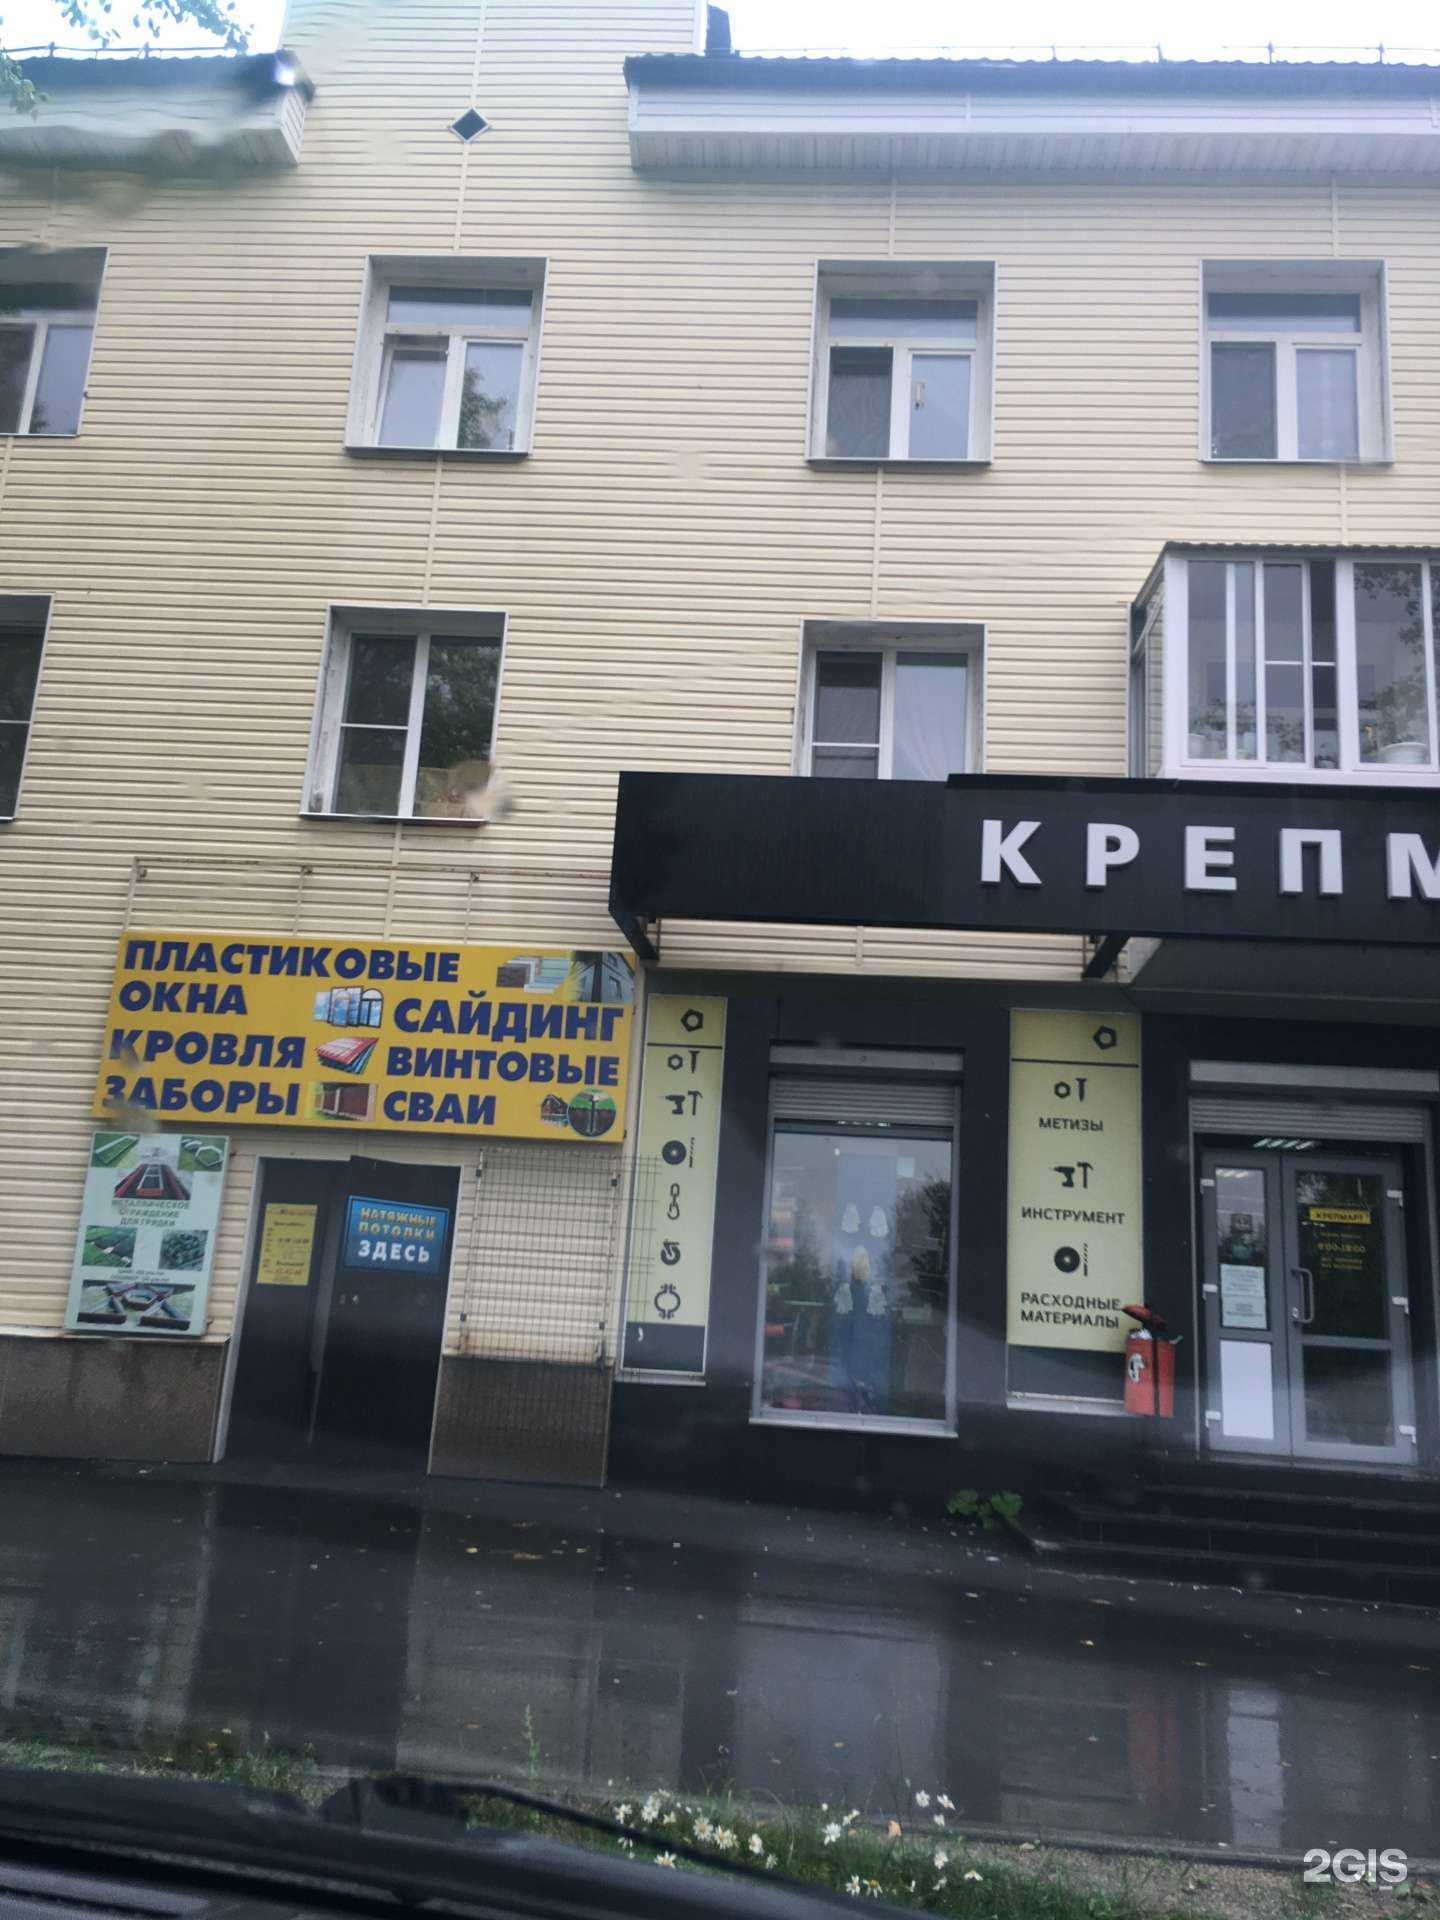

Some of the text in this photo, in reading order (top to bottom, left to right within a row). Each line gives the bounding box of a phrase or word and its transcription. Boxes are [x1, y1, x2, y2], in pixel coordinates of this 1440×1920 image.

[123, 939, 460, 983] ПЛАСТИКОВЫЕ
[118, 979, 248, 1016] ОКНА
[393, 989, 625, 1044] САЙДИНГ
[108, 1028, 307, 1069] КРОВЛЯ
[386, 1046, 620, 1087] ВИНТОВЫЕ
[103, 1075, 301, 1116] ЗАБОРЫ
[383, 1089, 497, 1126] СВАИ
[1039, 1116, 1104, 1132] МЕТИЗЫ
[112, 1198, 190, 1210] ЕТАЛЛИЧЕСКОЕ
[1021, 1205, 1125, 1225] ИНСТРУМЕНТ
[360, 1207, 436, 1226] НАТЯЖНЫЕ
[358, 1221, 434, 1240] ПОТОЛКИ
[358, 1239, 430, 1263] ЗДЕСЬ
[1020, 1291, 1121, 1312] РАСХОДНЫЕ
[1020, 1309, 1120, 1329] МАТЕРИАЛЫ
